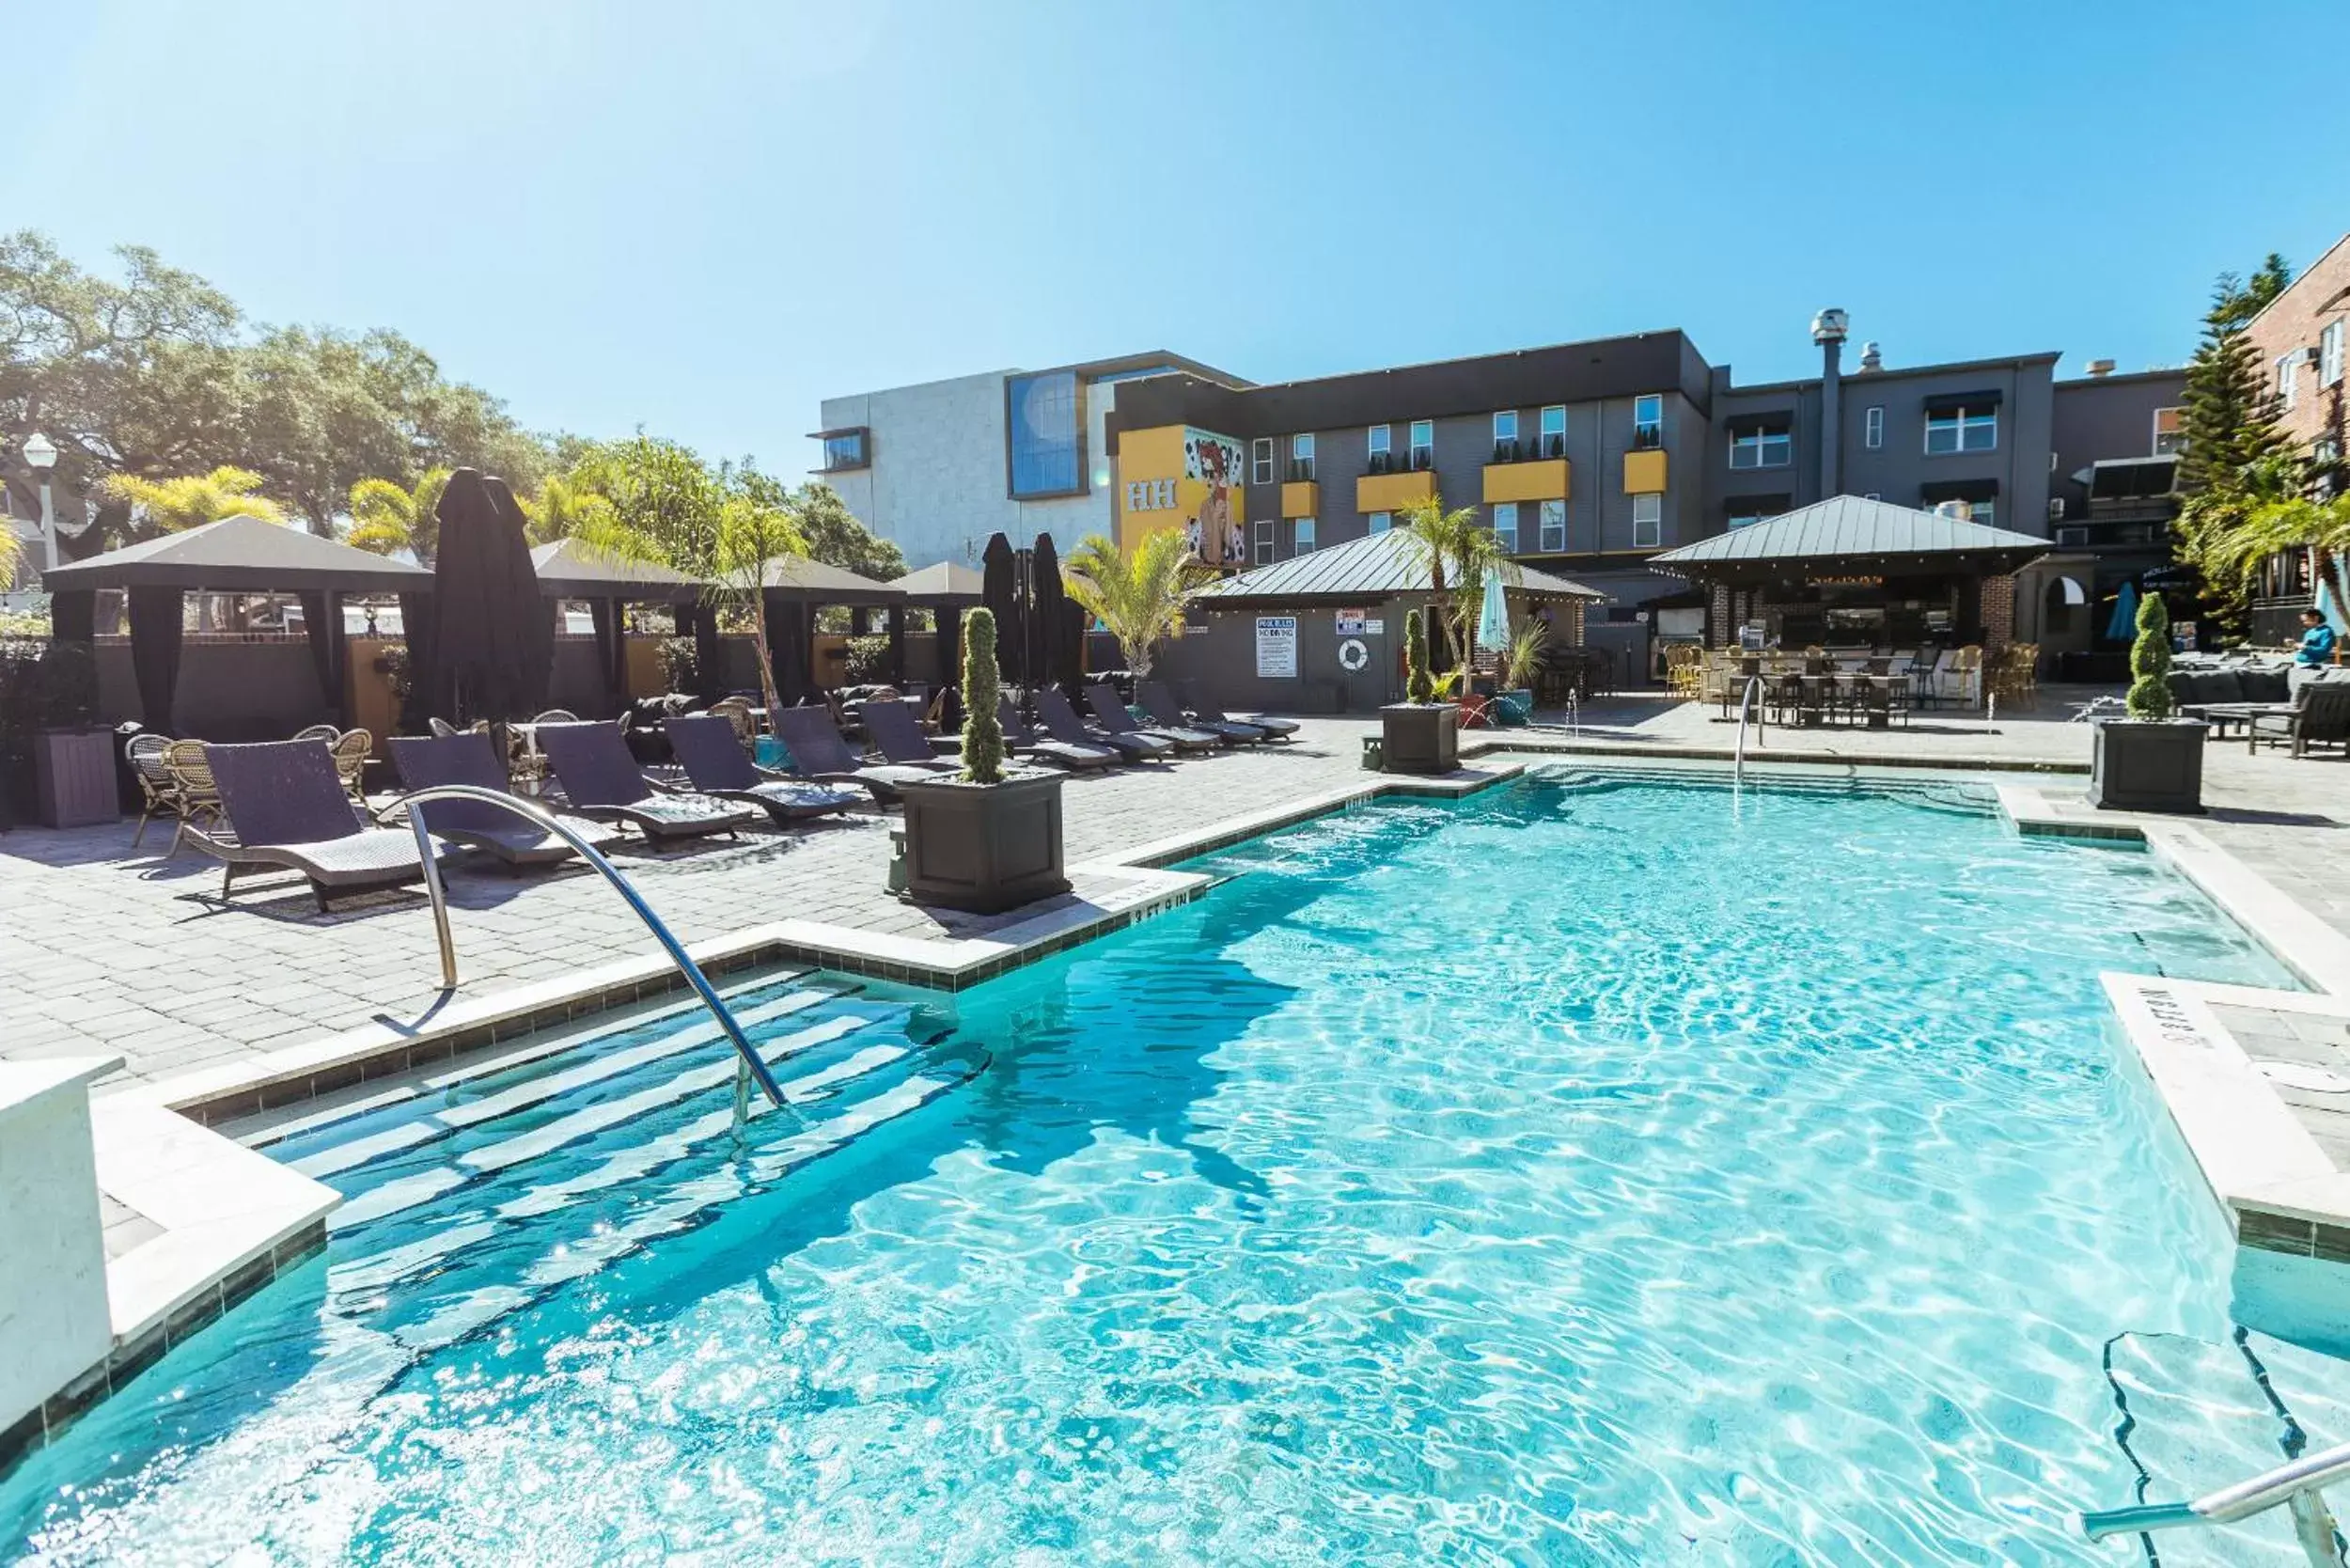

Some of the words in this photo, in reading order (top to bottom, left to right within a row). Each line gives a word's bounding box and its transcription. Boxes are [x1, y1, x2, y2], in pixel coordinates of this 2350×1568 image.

[1128, 479, 1177, 510] HH
[1146, 902, 1160, 917] FT
[1175, 892, 1187, 904] IN
